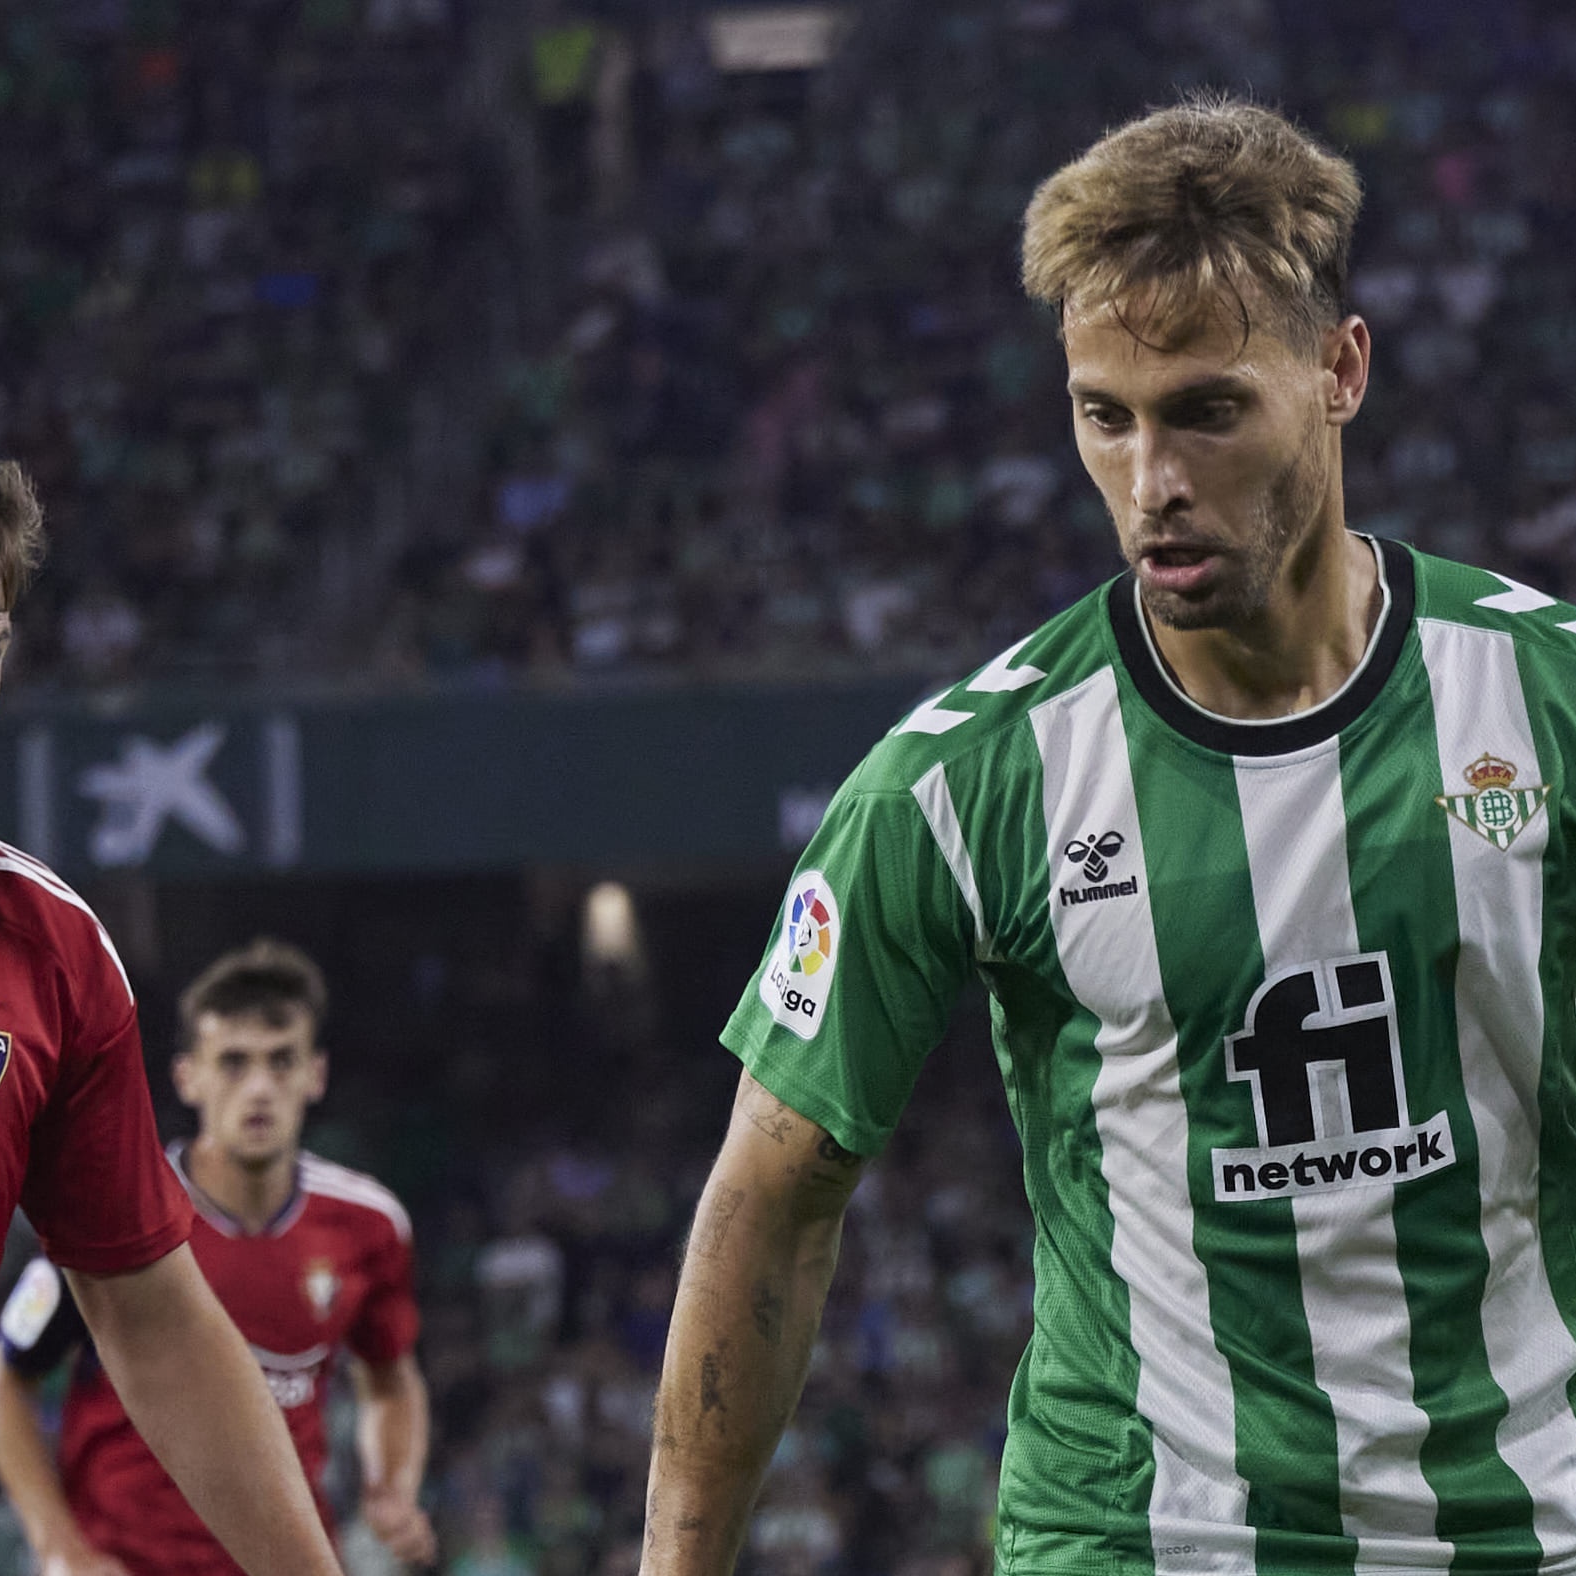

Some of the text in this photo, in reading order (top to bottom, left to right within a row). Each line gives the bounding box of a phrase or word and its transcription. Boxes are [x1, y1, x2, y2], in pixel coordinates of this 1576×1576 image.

[1060, 876, 1137, 907] hummel
[1233, 960, 1401, 1148] fi
[1223, 1130, 1446, 1193] network
